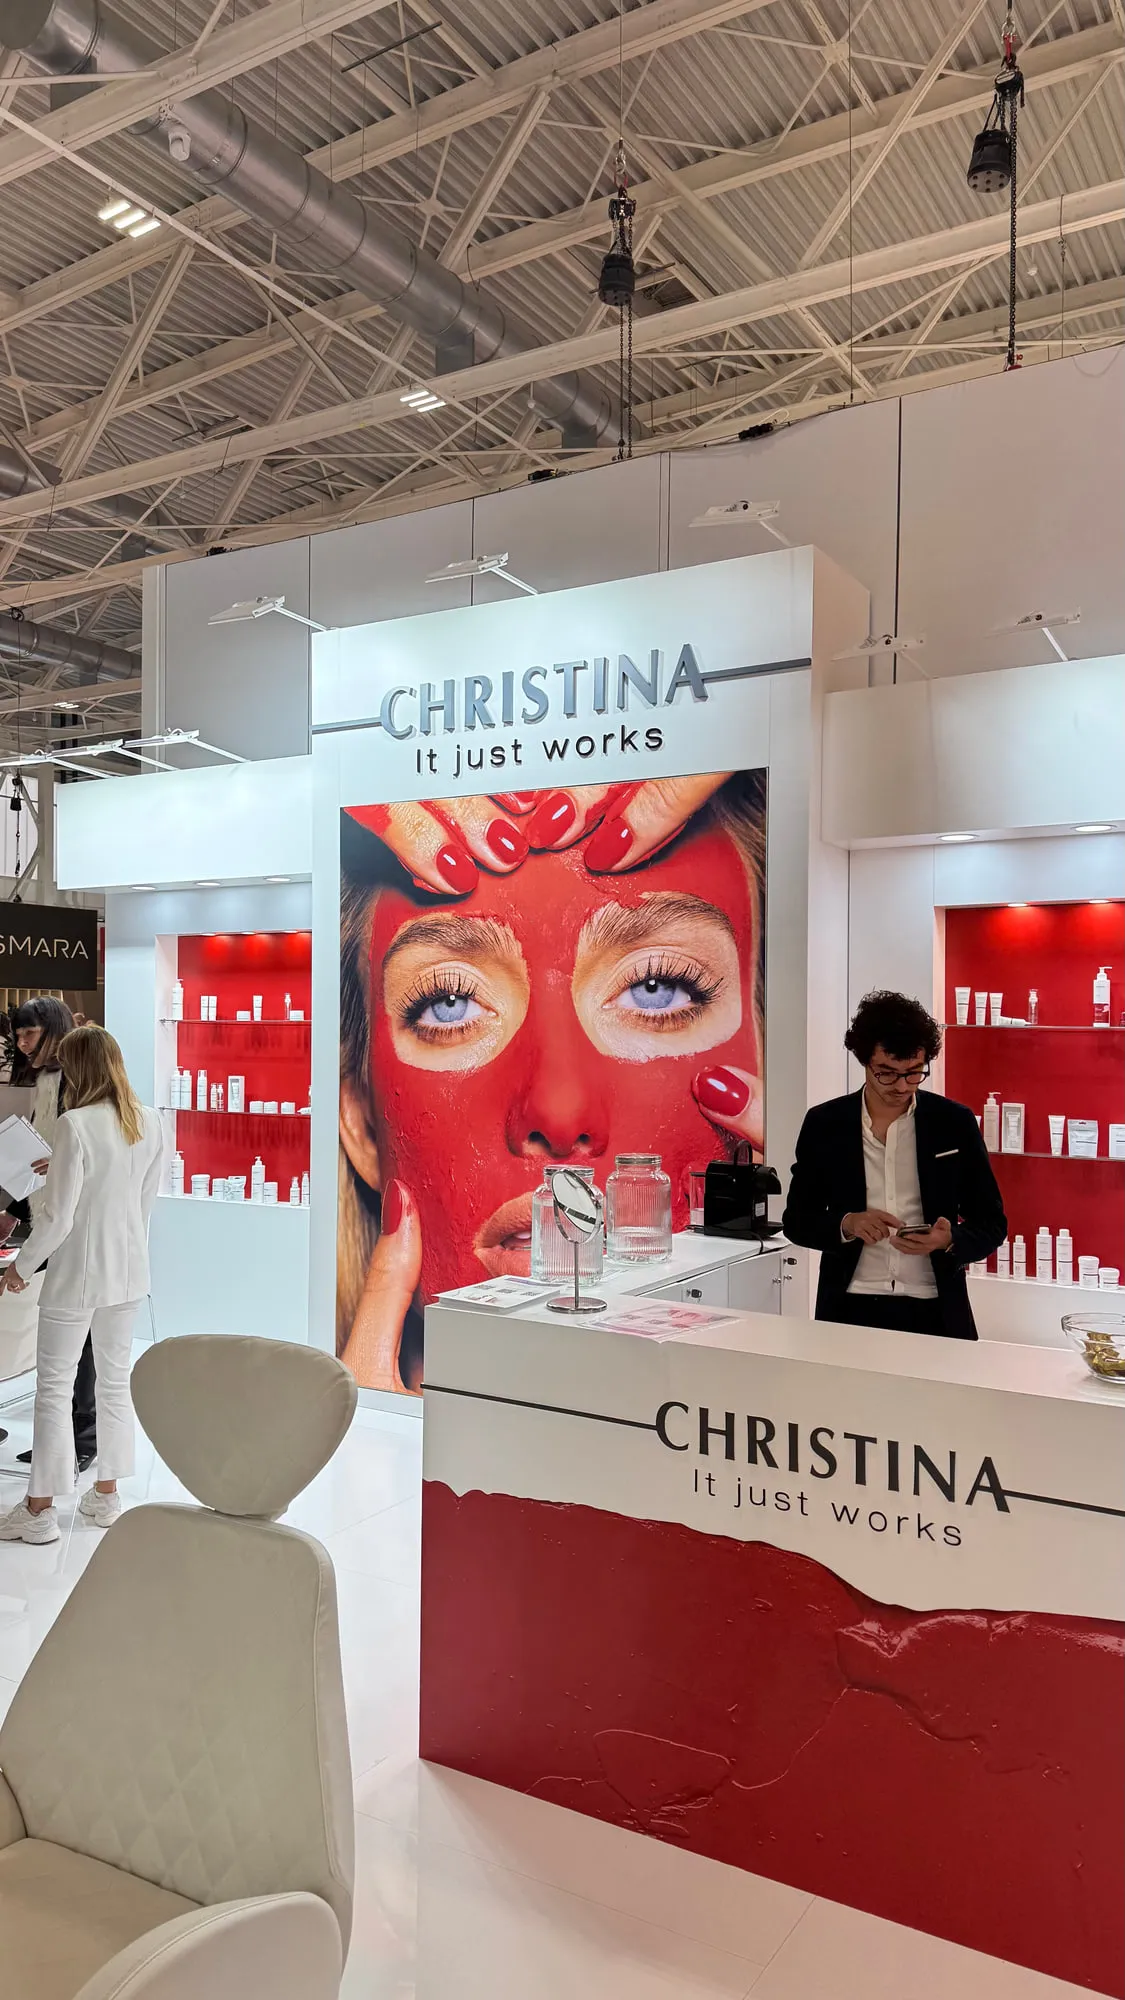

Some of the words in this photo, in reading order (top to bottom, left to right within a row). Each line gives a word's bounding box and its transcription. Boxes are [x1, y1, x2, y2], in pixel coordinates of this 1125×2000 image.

[380, 643, 709, 740] CHRISTINA
[416, 748, 438, 774] It
[453, 738, 523, 778] just
[541, 724, 664, 762] works
[655, 1400, 1011, 1514] CHRISTINA
[693, 1468, 717, 1497] It
[733, 1476, 809, 1517] just
[831, 1501, 962, 1546] works
